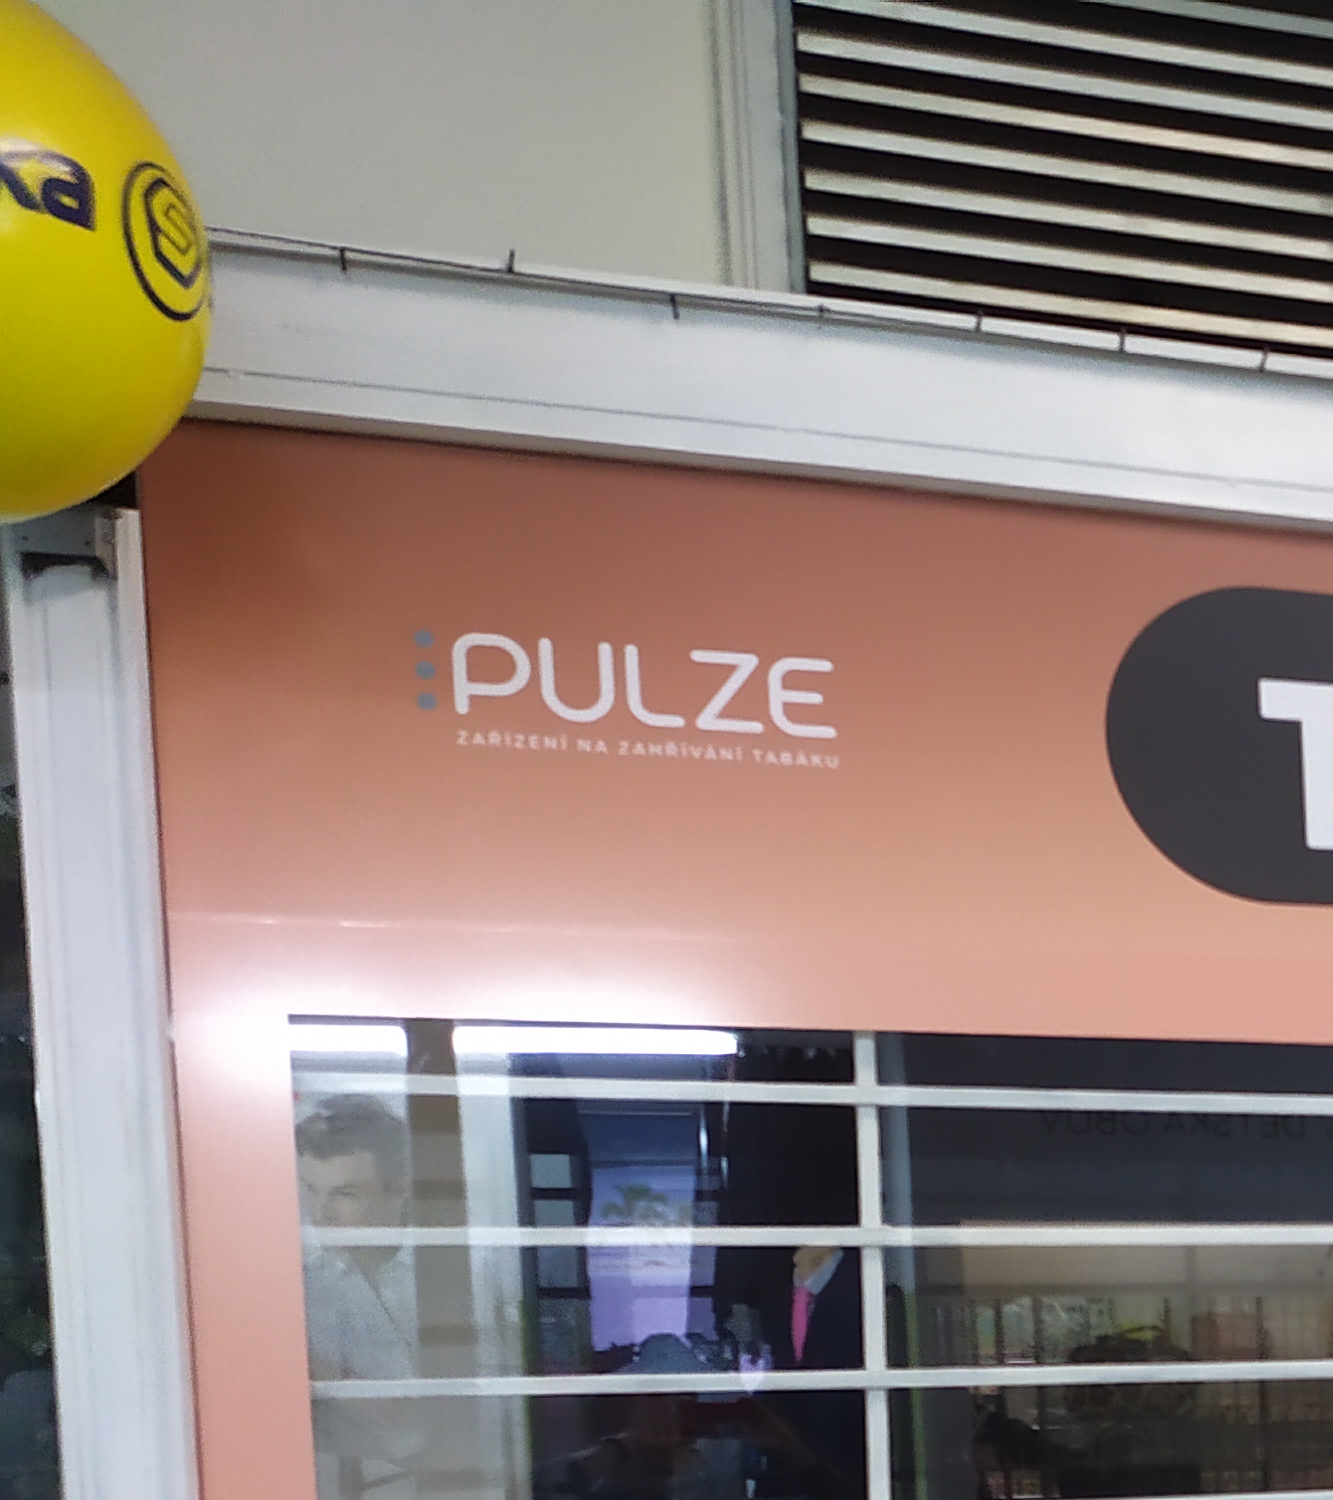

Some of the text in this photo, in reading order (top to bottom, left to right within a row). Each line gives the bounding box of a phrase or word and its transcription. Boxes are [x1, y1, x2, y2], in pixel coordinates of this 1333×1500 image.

[452, 632, 837, 739] PULZE
[456, 730, 568, 752] ZAŘÍZENÍ
[577, 738, 608, 755] NA
[752, 748, 840, 770] TABÁKU
